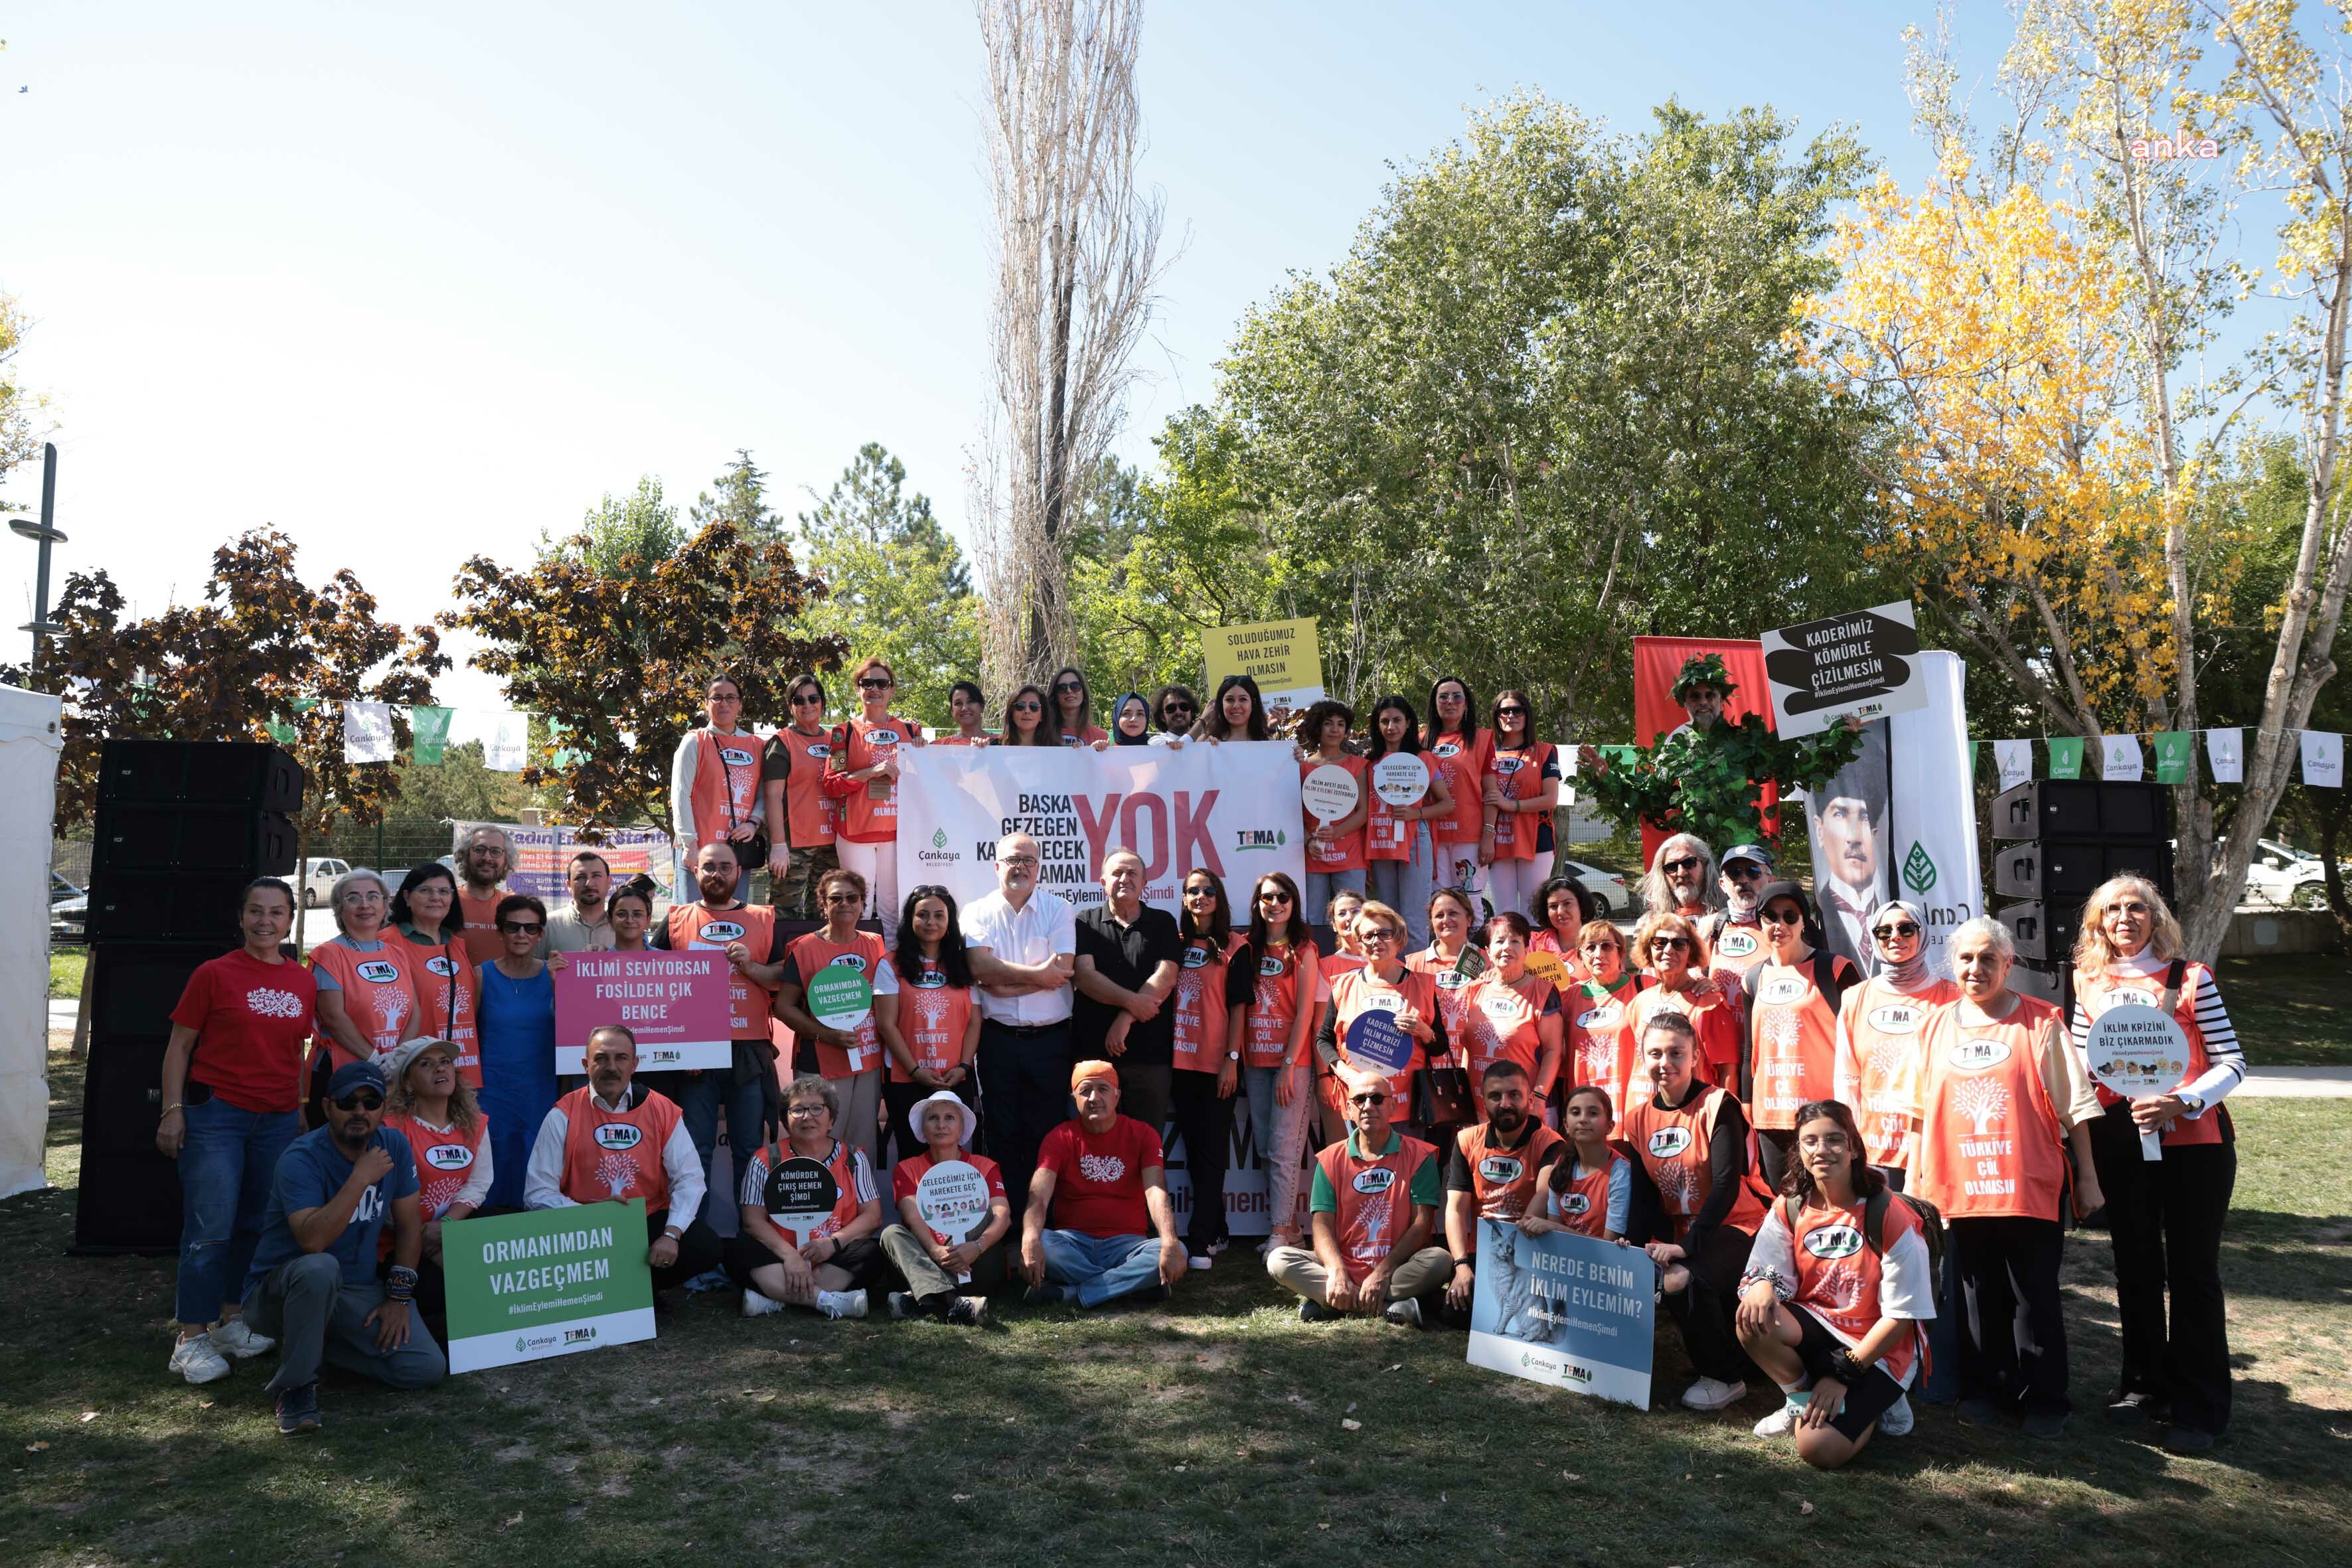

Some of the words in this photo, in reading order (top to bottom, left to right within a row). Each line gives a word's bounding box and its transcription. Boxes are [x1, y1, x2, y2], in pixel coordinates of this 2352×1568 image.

[1228, 628, 1296, 646] SOLUDUĞUMUZ
[1806, 619, 1874, 647] KADERİMİZ
[1237, 650, 1261, 661] HAVA
[1264, 645, 1291, 658] ZEHİR
[1814, 641, 1873, 666] KÖMÜRLE
[1246, 662, 1286, 676] OLMASIN
[1811, 659, 1883, 691] ÇİZİLMESİN
[1858, 704, 1877, 715] TEMA
[725, 751, 744, 759] TEMA
[2106, 763, 2138, 771] Çankaya
[1019, 794, 1072, 815] BAŞKA
[1001, 817, 1077, 836] GEZEGEN
[1371, 815, 1393, 826] TÜRKİY
[1071, 790, 1226, 882] YOK
[1237, 830, 1275, 845] TEMA
[919, 850, 960, 861] Çankaya
[977, 840, 1085, 860] KAECEK
[1036, 864, 1085, 884] AMAN
[1724, 937, 1745, 948] TMA
[364, 964, 391, 975] TEMA
[576, 959, 620, 977] İKLİMİ
[626, 958, 710, 977] SEVİYORSAN
[596, 981, 663, 999] FOSİLDEN
[669, 982, 692, 1001] ÇIK
[814, 979, 862, 994] ORMANIMDAN
[1769, 983, 1792, 994] TMA
[818, 991, 862, 1004] VAZGEÇMEM
[2110, 992, 2138, 1004] TMA
[622, 1004, 668, 1020] BENCE
[1490, 1001, 1508, 1012] TMA
[730, 1018, 748, 1028] ASIN
[1249, 1016, 1283, 1028] TÜRKİYE
[1881, 1010, 1909, 1022] TMA
[2104, 1022, 2129, 1033] İKLİM
[2131, 1020, 2166, 1032] KRİZİNİ
[861, 1030, 876, 1044] ÇÖL
[1256, 1029, 1272, 1041] ÇÖL
[1364, 1026, 1381, 1040] İKLİM
[1382, 1034, 1401, 1047] KRİZİ
[2099, 1035, 2114, 1047] BİZ
[2117, 1035, 2174, 1048] ÇIKARMADIK
[1363, 1038, 1394, 1056] ÇİZMESİN
[455, 1056, 478, 1067] ASIN
[653, 1051, 674, 1060] TEMA
[603, 1129, 630, 1140] TEMA
[1656, 1134, 1679, 1146] TEMA
[435, 1148, 461, 1160] TEMA
[1959, 1138, 2012, 1158] TÜRKİYE
[1490, 1160, 1512, 1173] TEMA
[1977, 1158, 1999, 1178] ÇÖL
[781, 1170, 819, 1180] KÖMÜRDEN
[922, 1174, 965, 1187] GELECEĞİMİZ
[967, 1171, 981, 1182] İÇİN
[1362, 1172, 1385, 1184] TEMA
[778, 1183, 797, 1193] ÇIKIŞ
[798, 1182, 822, 1190] HEMEN
[929, 1185, 962, 1196] HAREKETE
[963, 1183, 977, 1192] GEÇ
[1964, 1178, 2015, 1195] OLMASIN
[790, 1191, 811, 1203] ŞİMDİ
[1565, 1196, 1581, 1207] TEMA
[483, 1227, 613, 1264] ORMANIMDAN
[490, 1259, 609, 1295] VAZGEÇMEM
[1531, 1251, 1584, 1279] NEREDE
[1589, 1265, 1634, 1290] BENİM
[509, 1292, 603, 1315] #İklimEylemiHemenŞimdi
[1530, 1274, 1567, 1301] İKLİM
[1573, 1287, 1643, 1319] EYLEMİM?
[1528, 1306, 1618, 1337] #İklimEylemiHemenŞimdi
[527, 1336, 556, 1347] Çankaya
[564, 1328, 589, 1341] TEMA
[1531, 1358, 1557, 1370] Çankaya
[1564, 1364, 1586, 1379] TEMA
